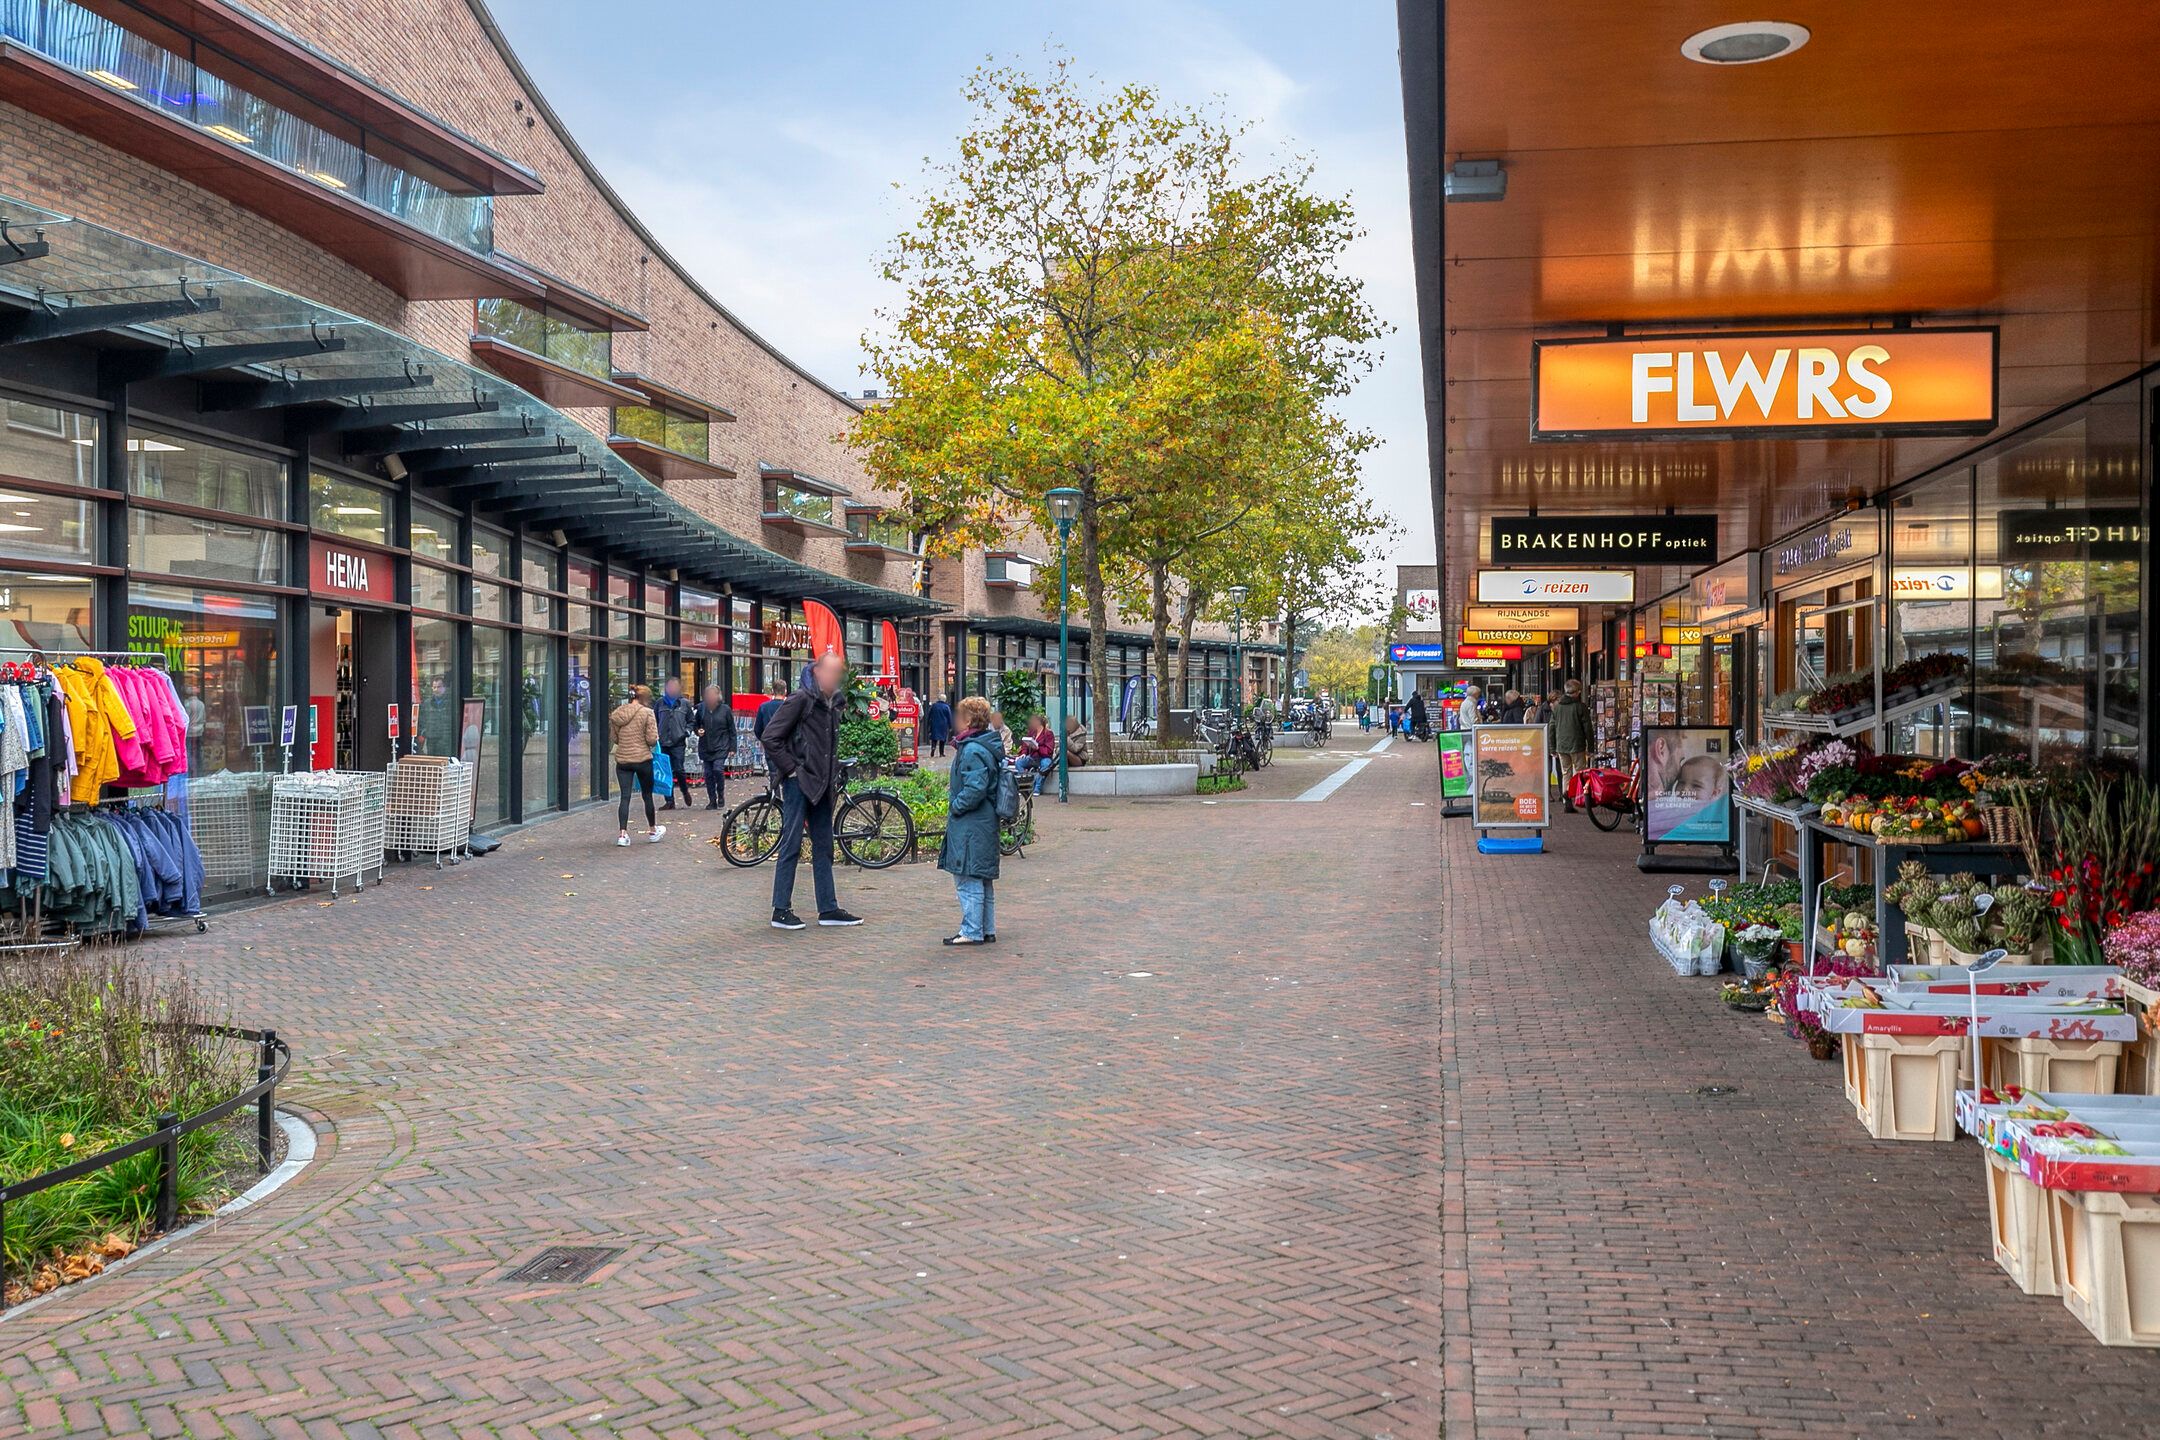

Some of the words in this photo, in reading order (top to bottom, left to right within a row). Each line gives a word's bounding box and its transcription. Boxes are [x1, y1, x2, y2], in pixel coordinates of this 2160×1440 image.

[1632, 345, 1893, 423] FLWRS
[1501, 533, 1662, 549] BRAKENHOFF
[1665, 538, 1707, 549] optiek
[327, 551, 369, 592] HEMA
[129, 615, 169, 640] STUUR
[1478, 630, 1532, 642] Intertoys
[1477, 648, 1503, 656] wibra
[1867, 1023, 1902, 1033] Amaryllis
